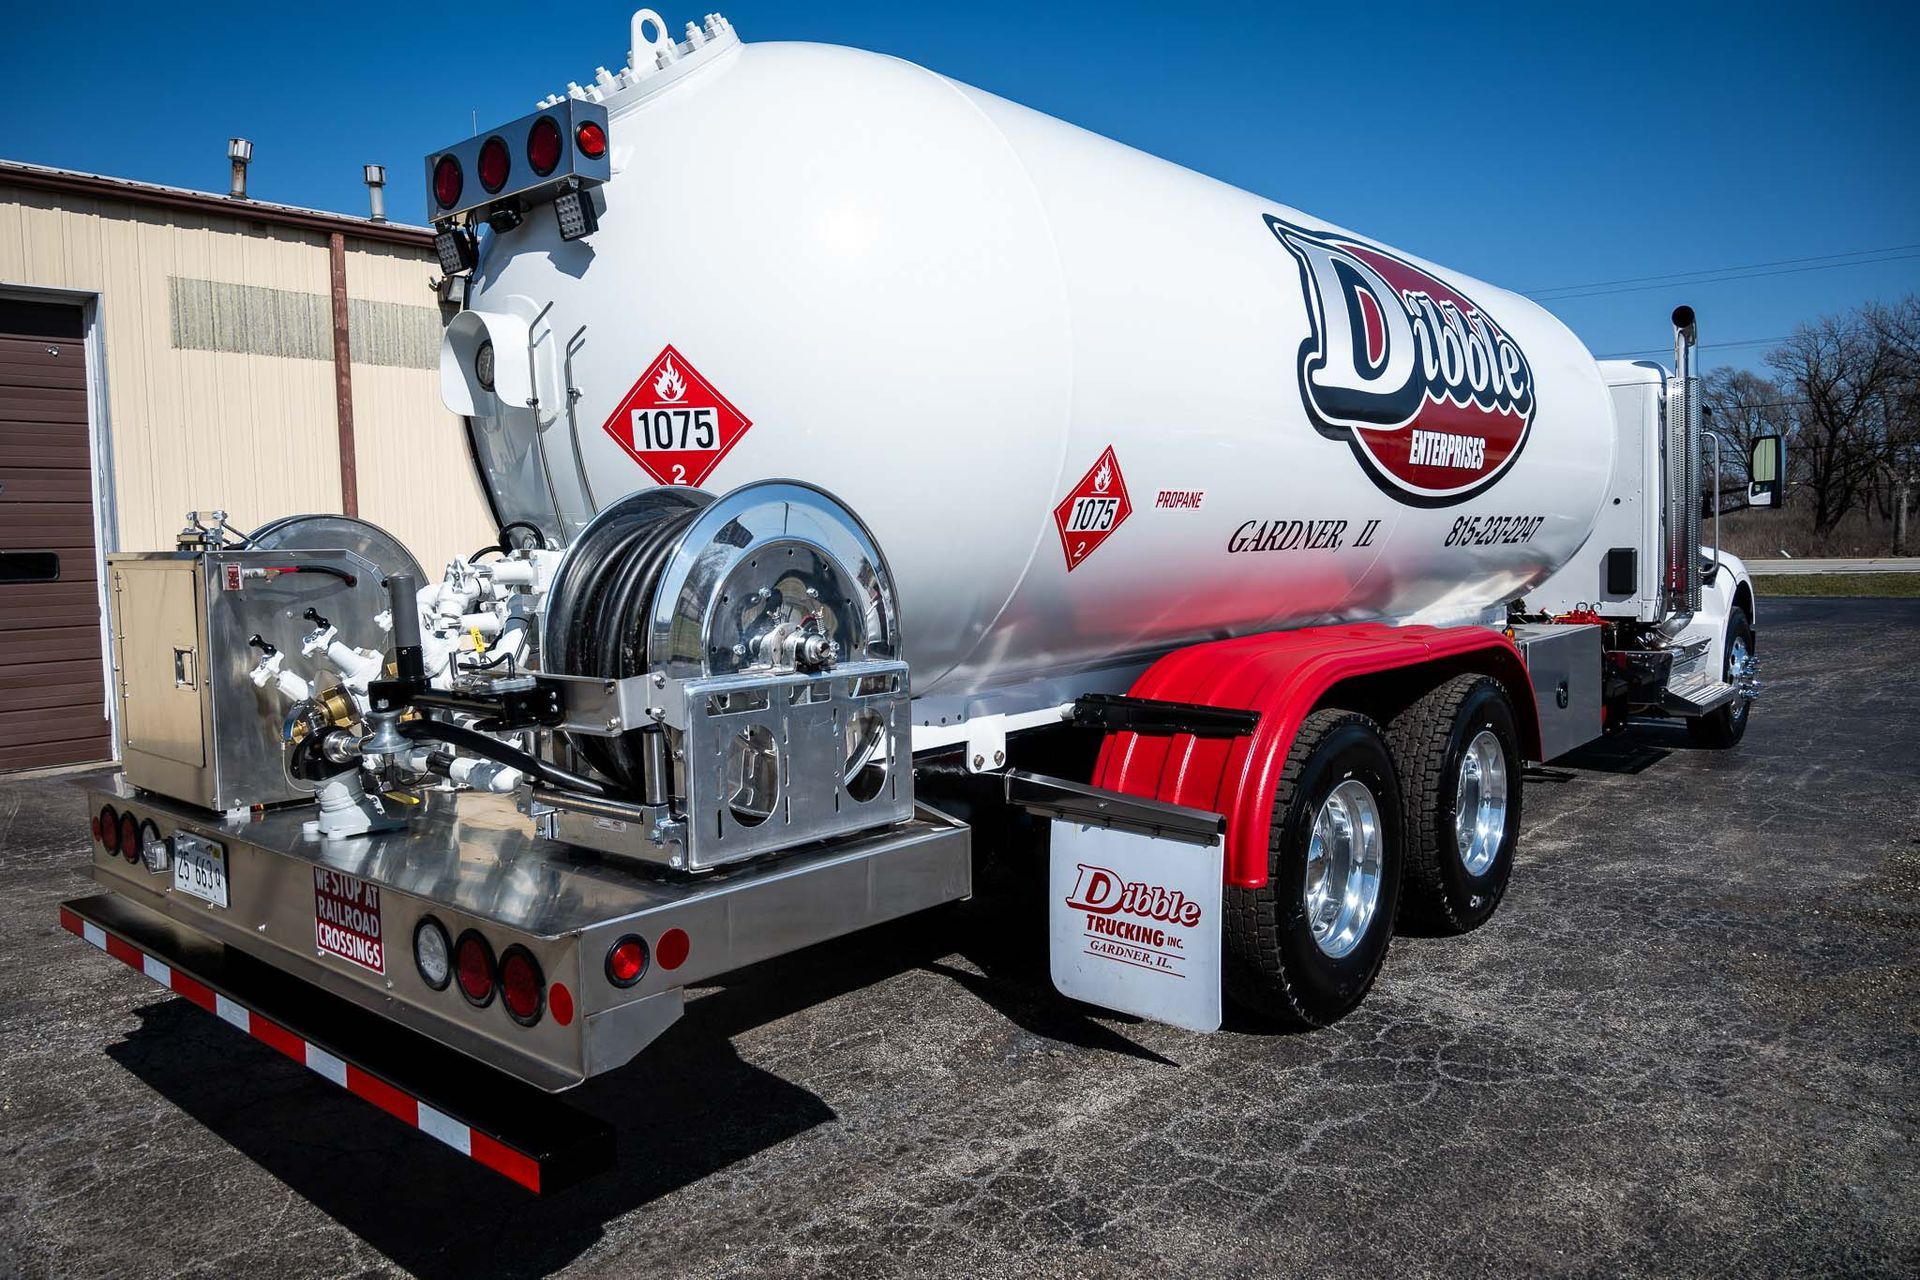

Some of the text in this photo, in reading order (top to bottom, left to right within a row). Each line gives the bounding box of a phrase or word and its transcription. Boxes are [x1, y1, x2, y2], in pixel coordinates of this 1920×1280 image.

[1268, 218, 1534, 424] Dibble
[638, 410, 714, 450] 1075
[1408, 429, 1486, 470] ENTERPRISES
[671, 464, 687, 485] 2
[1072, 499, 1117, 531] 1075
[1155, 491, 1204, 509] PROPANE
[1227, 519, 1348, 553] GARDNER,
[1444, 516, 1545, 548] 815-237-2247
[1073, 541, 1086, 558] 2
[178, 850, 190, 880] 25
[315, 867, 330, 893] WE
[365, 884, 378, 909] AT
[1065, 863, 1201, 928] Dibble
[317, 895, 380, 938] RAILROAD
[1087, 914, 1184, 949] TRUCKING INC.
[318, 922, 382, 968] CROSSINGS
[1090, 940, 1173, 969] GARDNER, IL.
